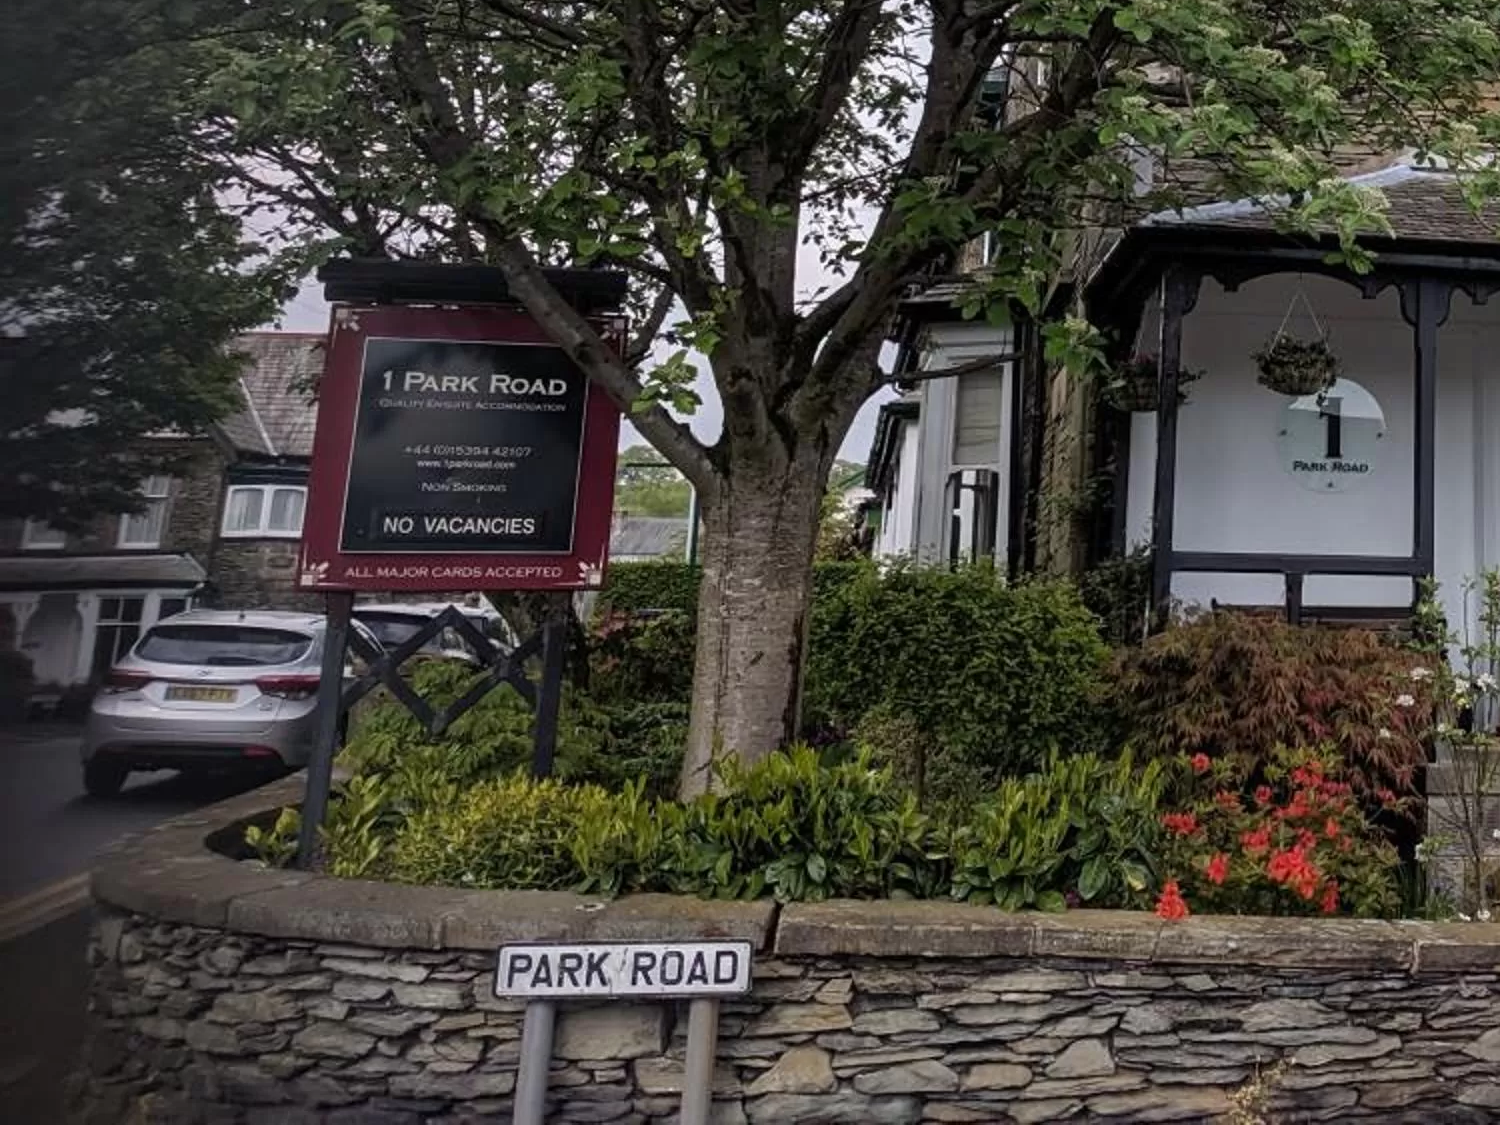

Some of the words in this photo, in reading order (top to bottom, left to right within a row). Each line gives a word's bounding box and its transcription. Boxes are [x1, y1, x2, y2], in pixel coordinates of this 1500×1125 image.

[383, 370, 393, 391] 1
[1319, 397, 1343, 459] 1
[383, 517, 413, 534] NO
[424, 517, 535, 535] VACANCIES
[345, 567, 373, 578] ALL
[376, 567, 429, 578] MAJOR
[431, 567, 483, 578] CARDS
[485, 567, 562, 578] ACCEPTED
[506, 952, 611, 988] PARK
[631, 950, 739, 986] ROAD
